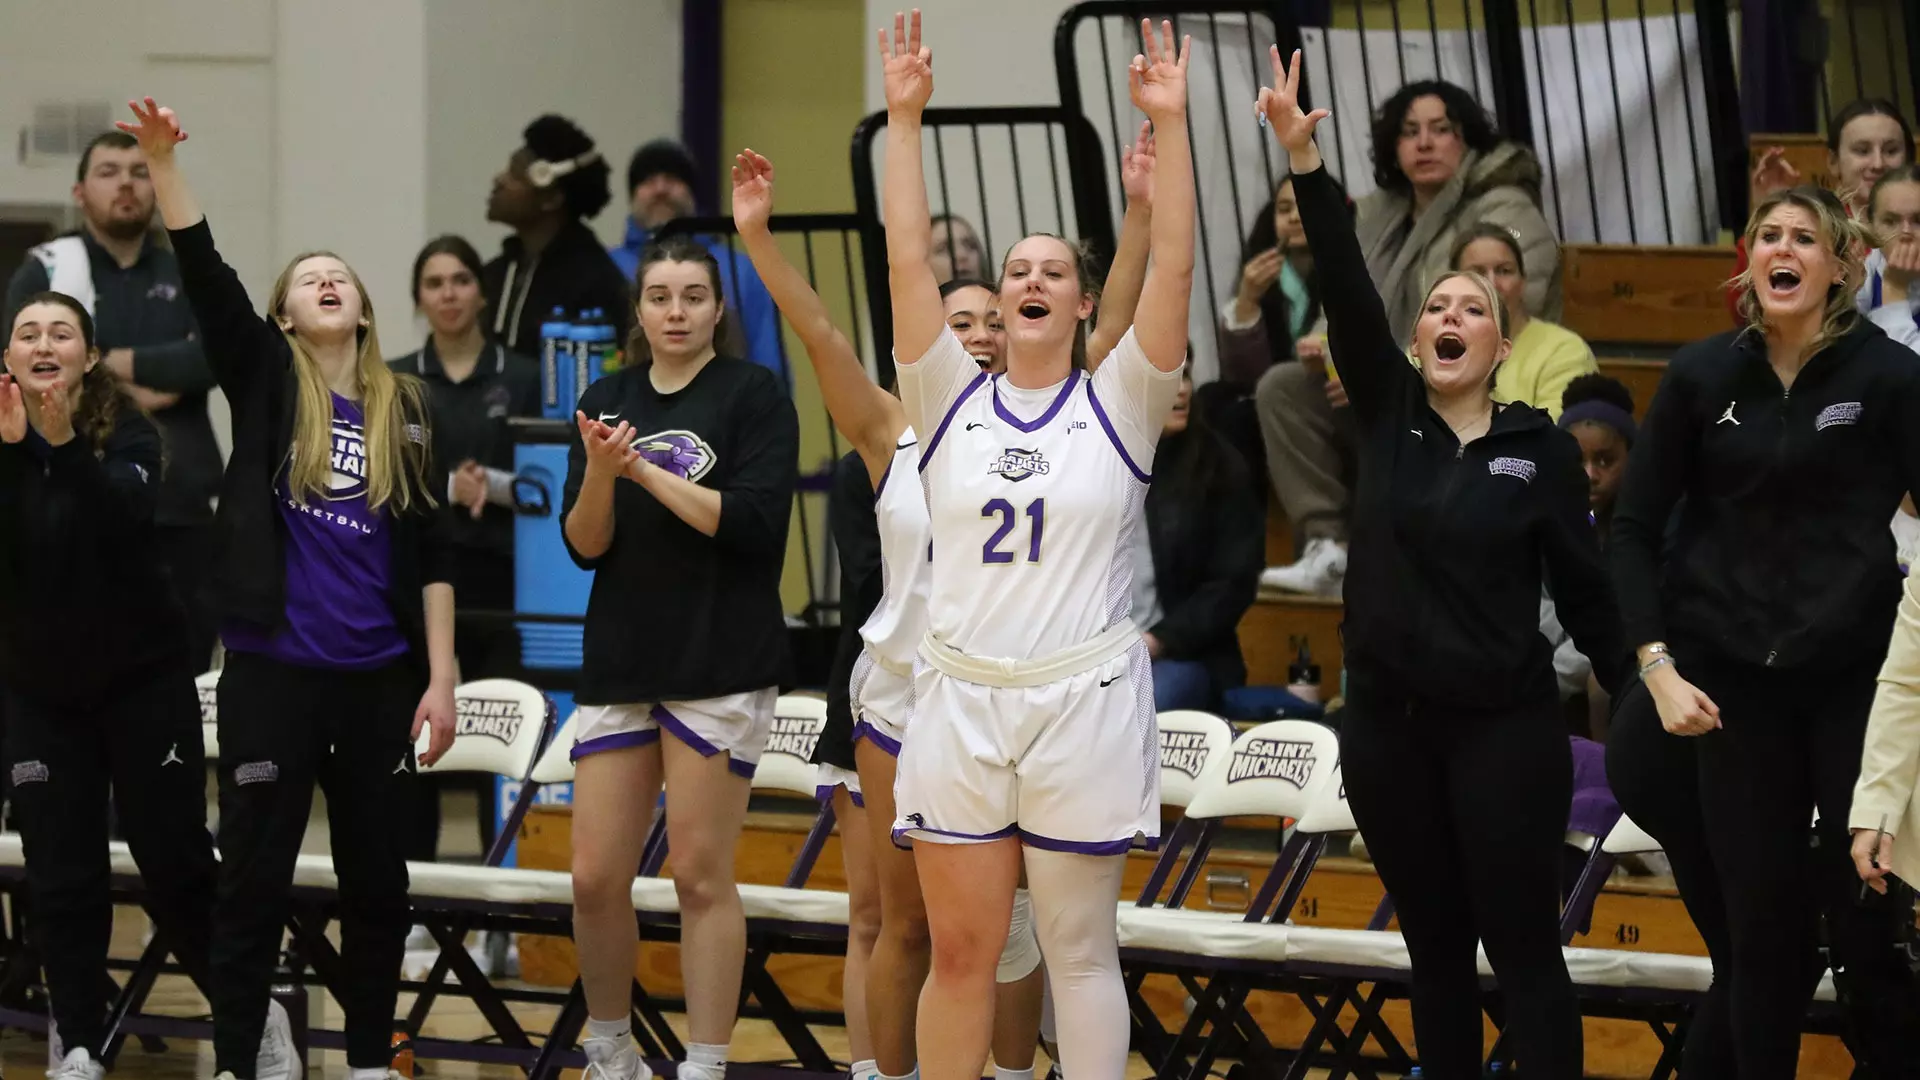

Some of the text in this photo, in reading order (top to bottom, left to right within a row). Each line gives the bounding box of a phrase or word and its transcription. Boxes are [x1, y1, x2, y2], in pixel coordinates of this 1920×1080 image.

[980, 496, 1046, 566] 21
[1159, 730, 1206, 749] AINT
[1248, 738, 1314, 759] SAINT
[1615, 922, 1640, 945] 49
